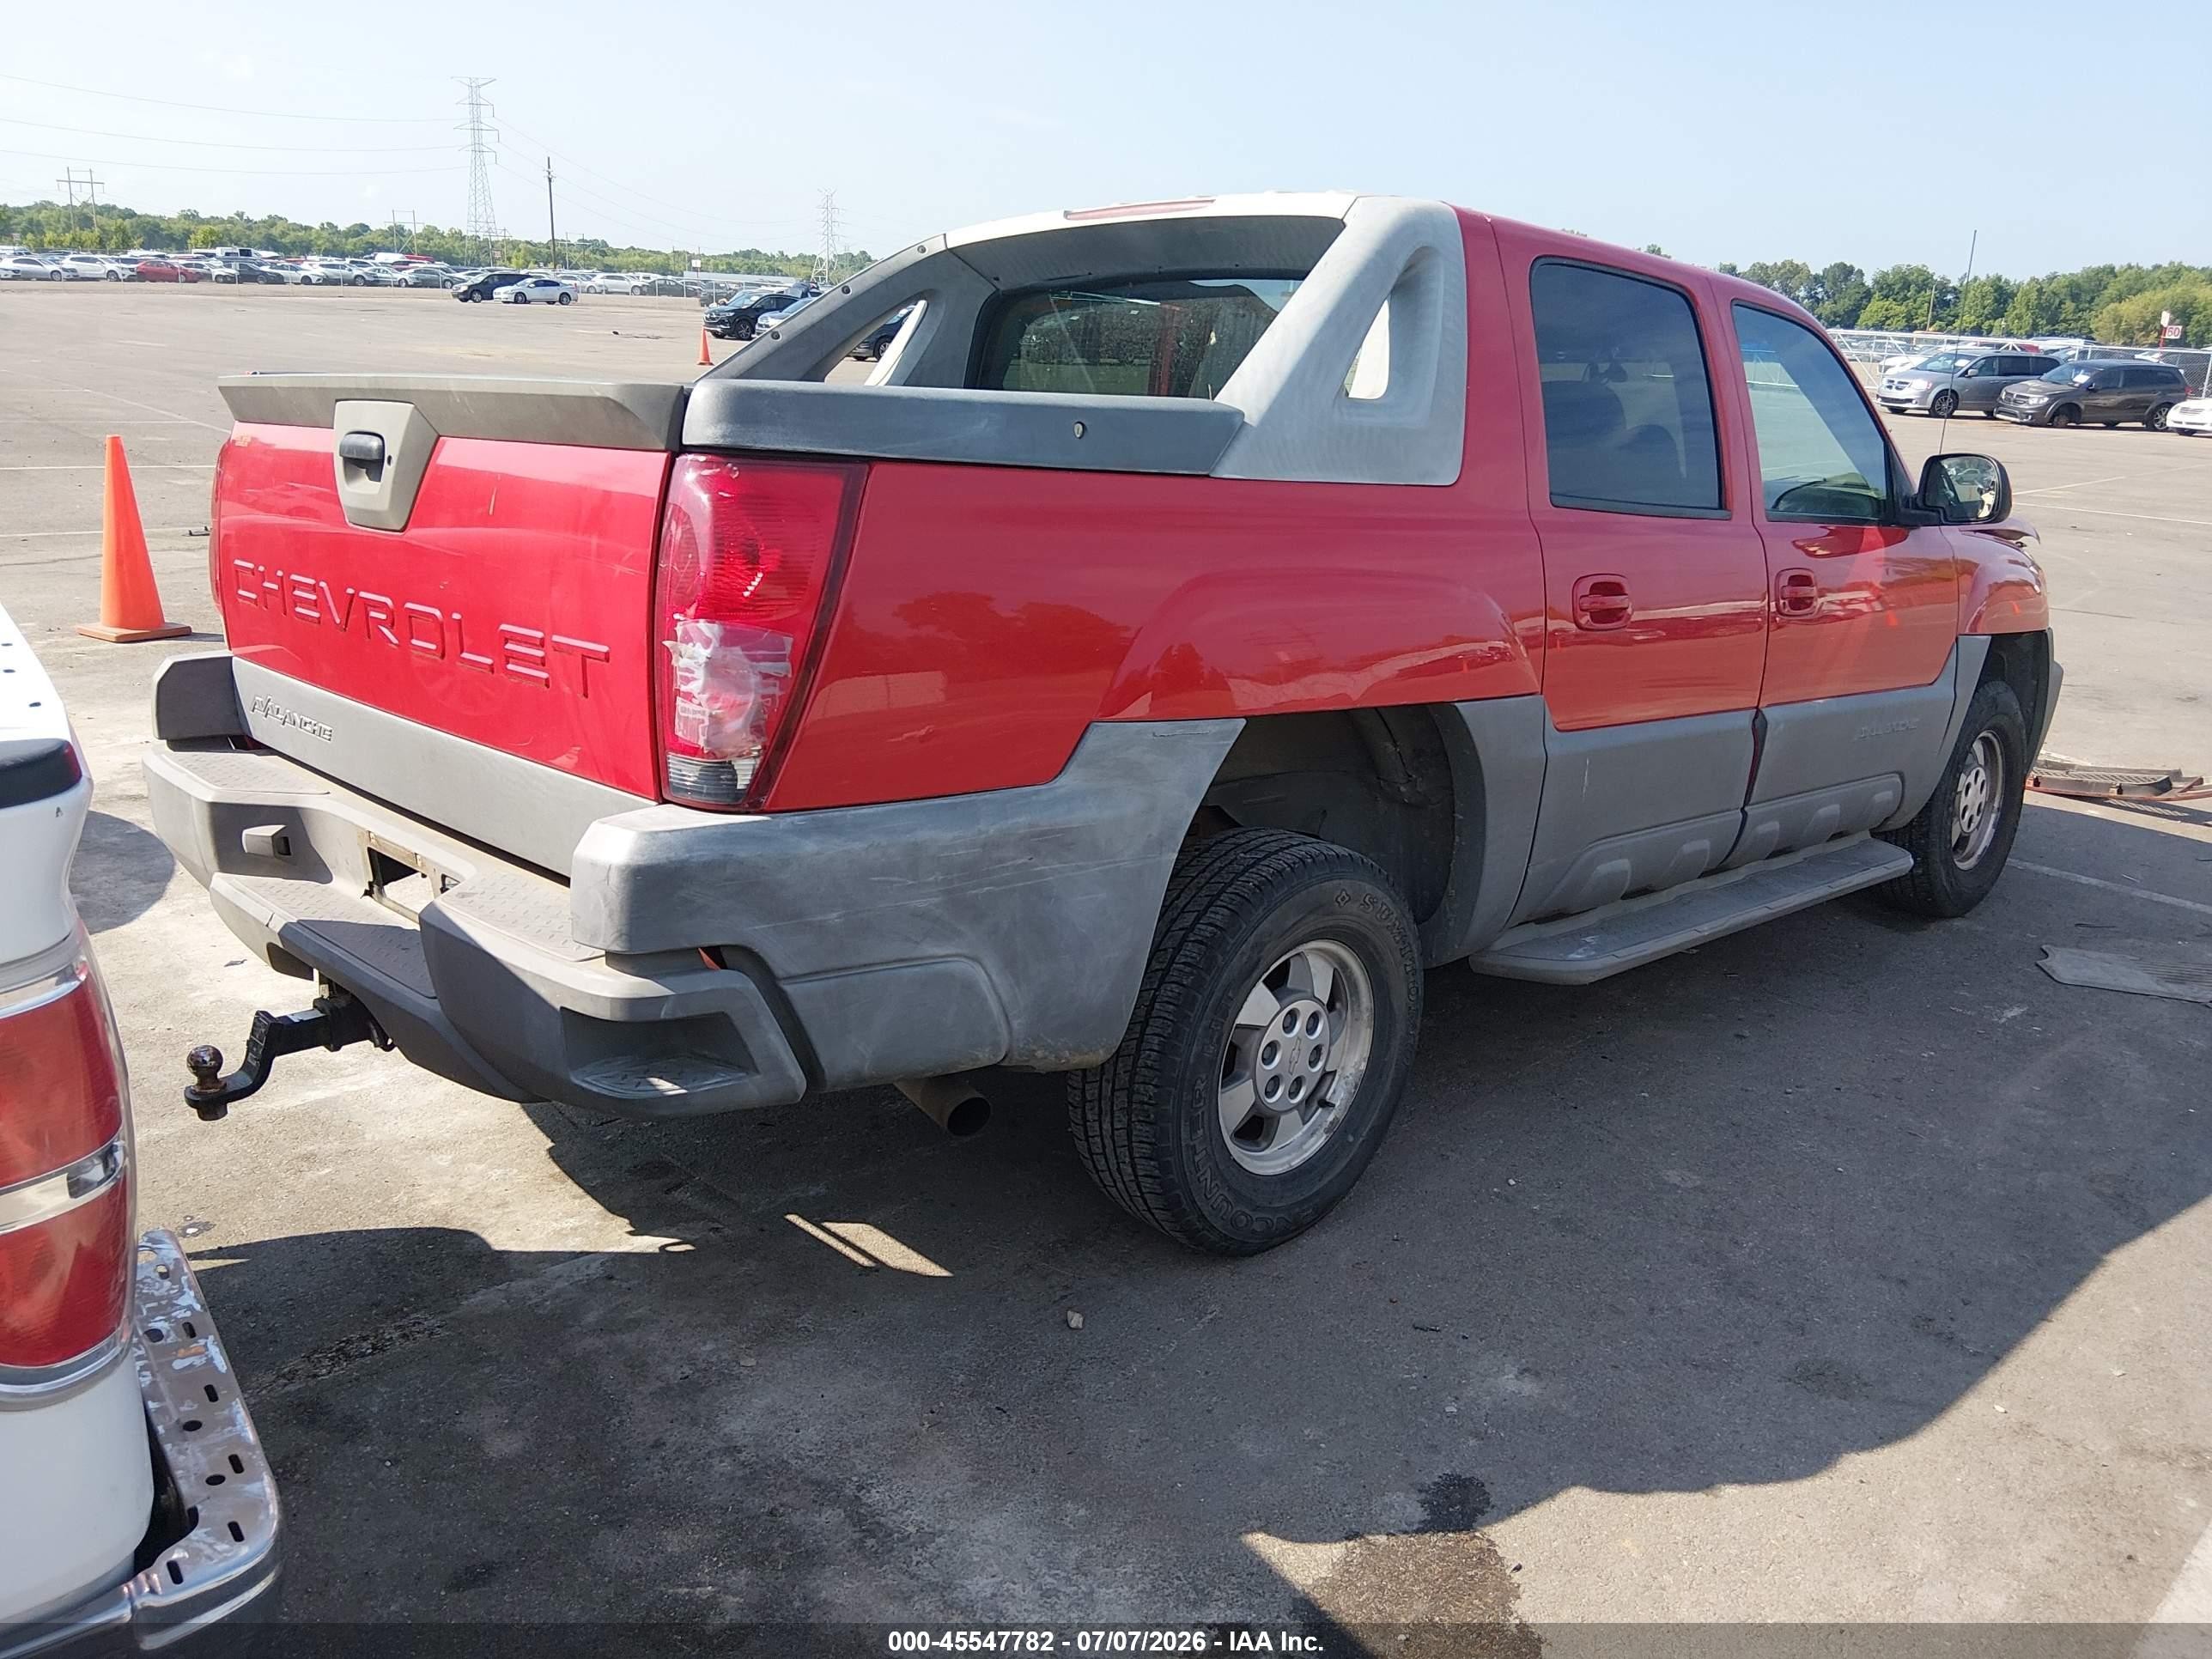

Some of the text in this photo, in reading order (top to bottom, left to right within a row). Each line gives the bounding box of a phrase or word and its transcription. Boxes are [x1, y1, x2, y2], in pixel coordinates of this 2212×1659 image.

[2167, 327, 2180, 337] 60
[233, 559, 610, 699] CHEVROLET
[251, 693, 333, 742] AVALANCHE
